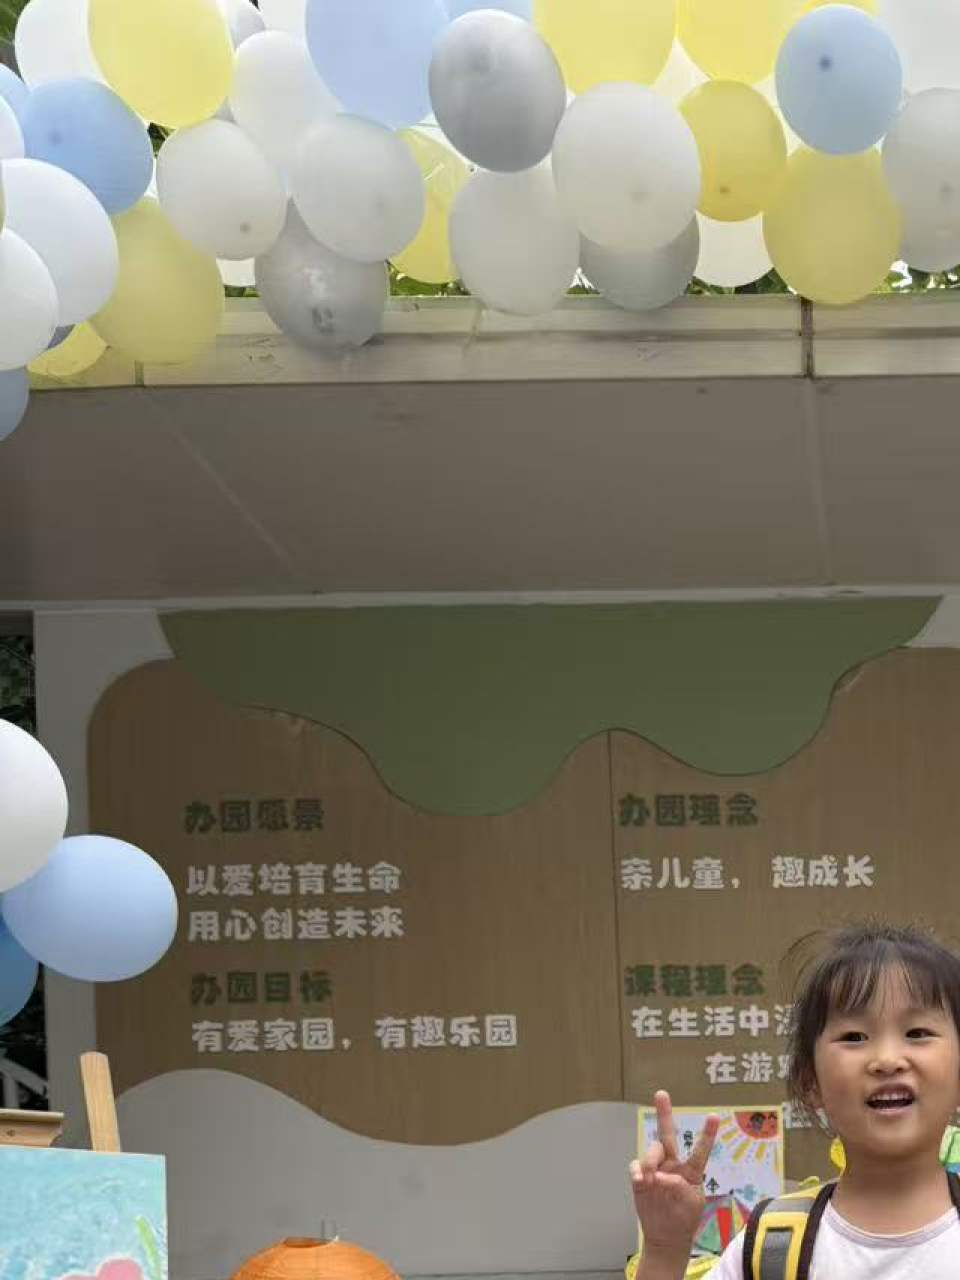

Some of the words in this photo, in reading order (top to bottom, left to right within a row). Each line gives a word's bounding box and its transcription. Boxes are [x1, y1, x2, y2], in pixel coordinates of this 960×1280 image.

[184, 799, 324, 834] 办园愿景
[617, 792, 759, 827] 办园理念
[185, 862, 400, 897] 以爱培育生命
[188, 906, 404, 942] 用心创造未来
[190, 971, 333, 1006] 办园目标
[624, 963, 767, 997] 课程理念
